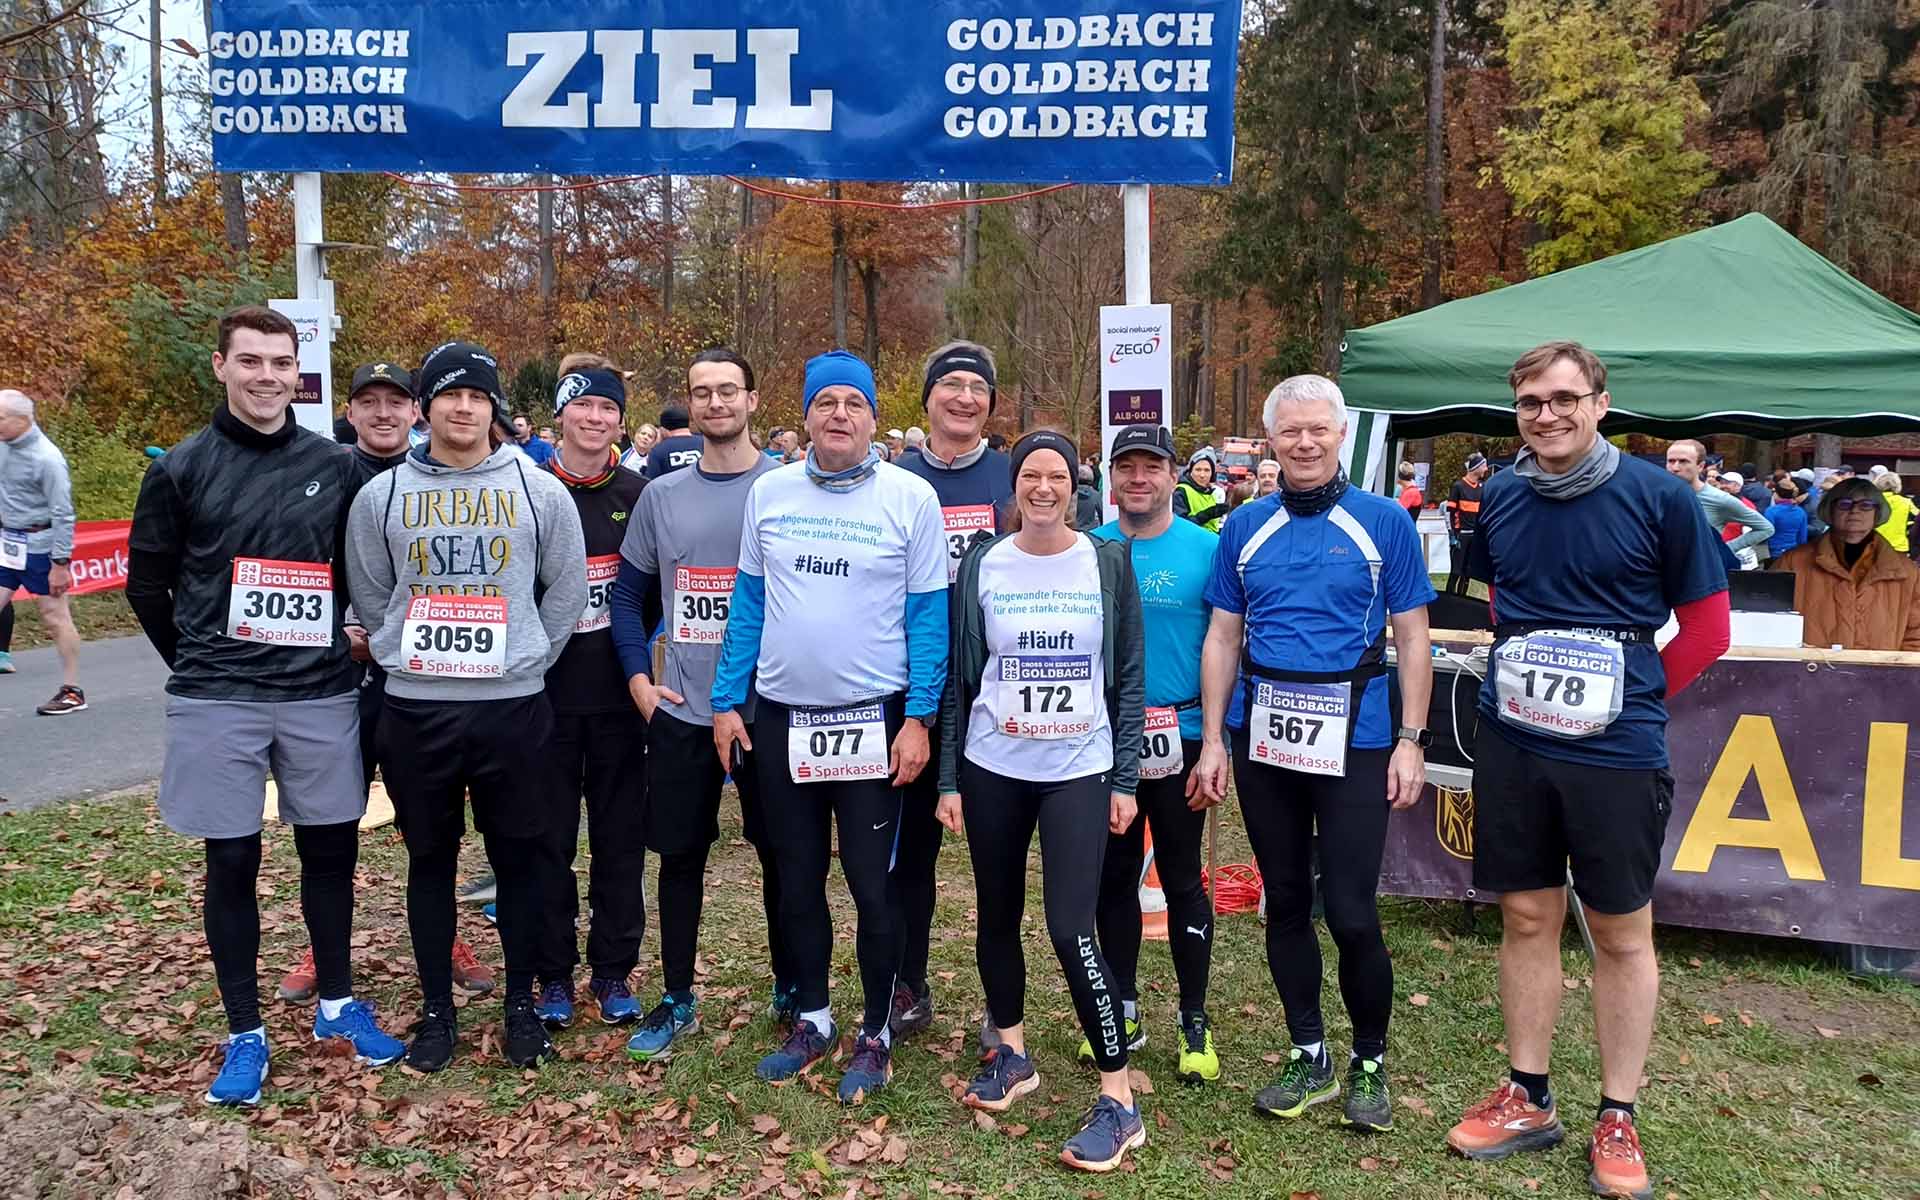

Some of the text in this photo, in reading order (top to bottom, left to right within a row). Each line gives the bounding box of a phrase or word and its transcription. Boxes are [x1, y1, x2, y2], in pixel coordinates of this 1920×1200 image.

[947, 13, 1215, 51] GOLDBACH
[210, 29, 409, 58] GOLDBACH
[211, 66, 408, 96] GOLDBACH
[502, 28, 833, 131] ZIEL
[944, 59, 1211, 95] GOLDBACH
[211, 105, 408, 133] GOLDBACH
[944, 105, 1208, 138] GOLDBACH
[1115, 343, 1153, 355] ZEGO
[1114, 411, 1157, 420] ALB-GOLD
[402, 488, 518, 529] URBAN
[780, 514, 882, 536] Angewandte Forschung
[791, 528, 810, 537] eine
[812, 530, 839, 540] starke
[241, 564, 256, 573] 24
[794, 554, 850, 577] #läuft
[240, 574, 256, 583] 25
[261, 574, 329, 587] GOLDBACH
[993, 590, 1050, 601] Angewandte
[244, 590, 322, 621] 3033
[429, 608, 503, 620] GOLDBACH
[994, 605, 1005, 615] für
[1008, 605, 1027, 614] eine
[1029, 604, 1059, 614] starke
[256, 627, 327, 642] Sparkasse
[414, 625, 493, 653] 3059
[1018, 630, 1075, 650] #läuft
[1004, 660, 1017, 669] 24
[1506, 651, 1520, 660] 25
[1526, 651, 1612, 672] GOLDBACH
[427, 660, 499, 674] Sparkasse
[1004, 670, 1017, 679] 25
[1021, 668, 1089, 678] GOLDBACH
[1260, 685, 1270, 695] 24
[1521, 670, 1586, 706] 178
[1019, 686, 1074, 713] 172
[1259, 695, 1270, 705] 25
[1273, 697, 1344, 713] GOLDBACH
[812, 710, 880, 723] GOLDBACH
[1523, 706, 1602, 731] Sparkasse
[1022, 721, 1090, 736] Sparkasse
[1269, 713, 1324, 746] 567
[810, 729, 863, 757] 077
[1271, 748, 1338, 769] Sparkasse
[814, 764, 883, 778] Sparkasse
[1078, 935, 1119, 1057] OCEANS APART
